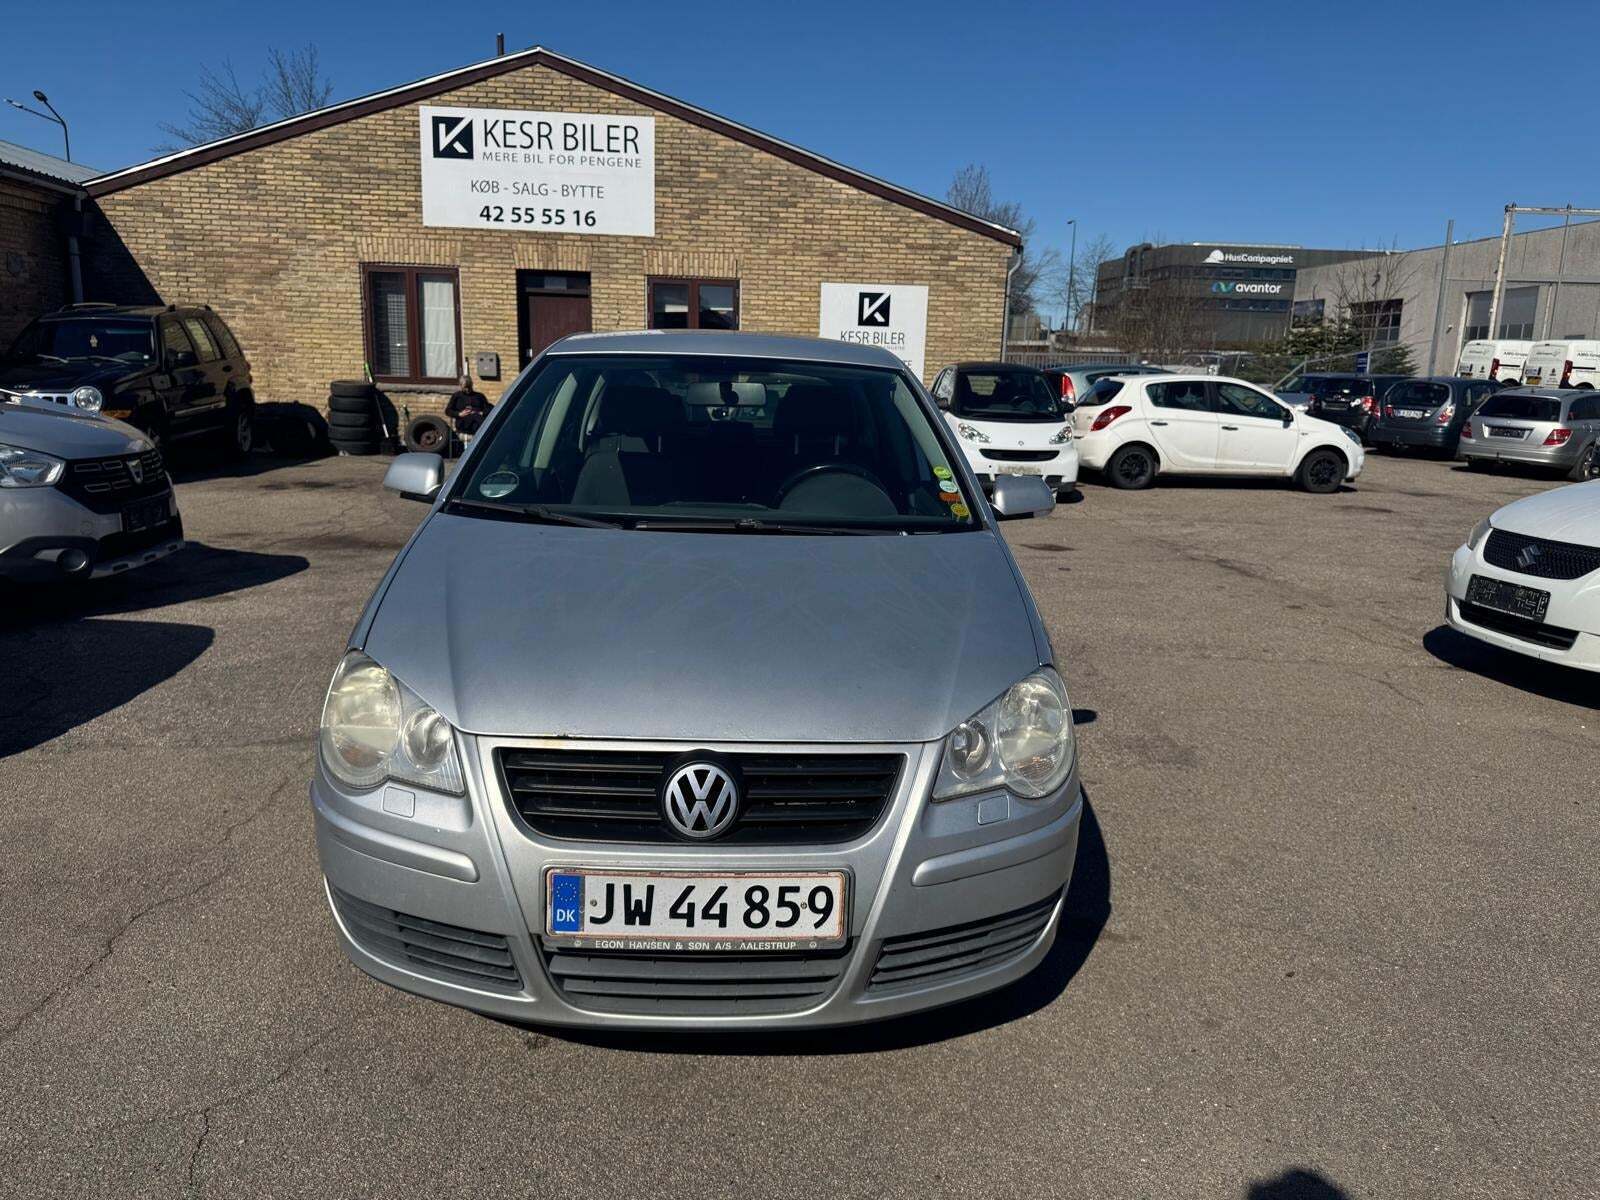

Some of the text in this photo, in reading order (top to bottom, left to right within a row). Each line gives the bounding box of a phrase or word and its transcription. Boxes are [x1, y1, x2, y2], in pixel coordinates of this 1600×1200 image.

[483, 119, 639, 154] KESR BILER
[482, 151, 642, 169] MERE BIL FOR PENGENE
[471, 179, 500, 194] KØB
[512, 181, 549, 196] SALG
[561, 184, 605, 199] BYTTE
[479, 205, 596, 227] 42 55 55 16
[1225, 253, 1294, 264] HusCompagniet
[1235, 282, 1281, 293] avantor
[840, 330, 905, 345] KESR BILER
[665, 763, 737, 838] VW
[589, 882, 834, 930] JW 44 859
[556, 909, 575, 923] DK
[595, 940, 624, 949] EGON
[629, 941, 670, 950] HANSEN
[675, 941, 683, 950] &
[688, 941, 710, 950] SØN
[714, 941, 732, 950] A/S
[739, 941, 797, 950] AALESTRUP
